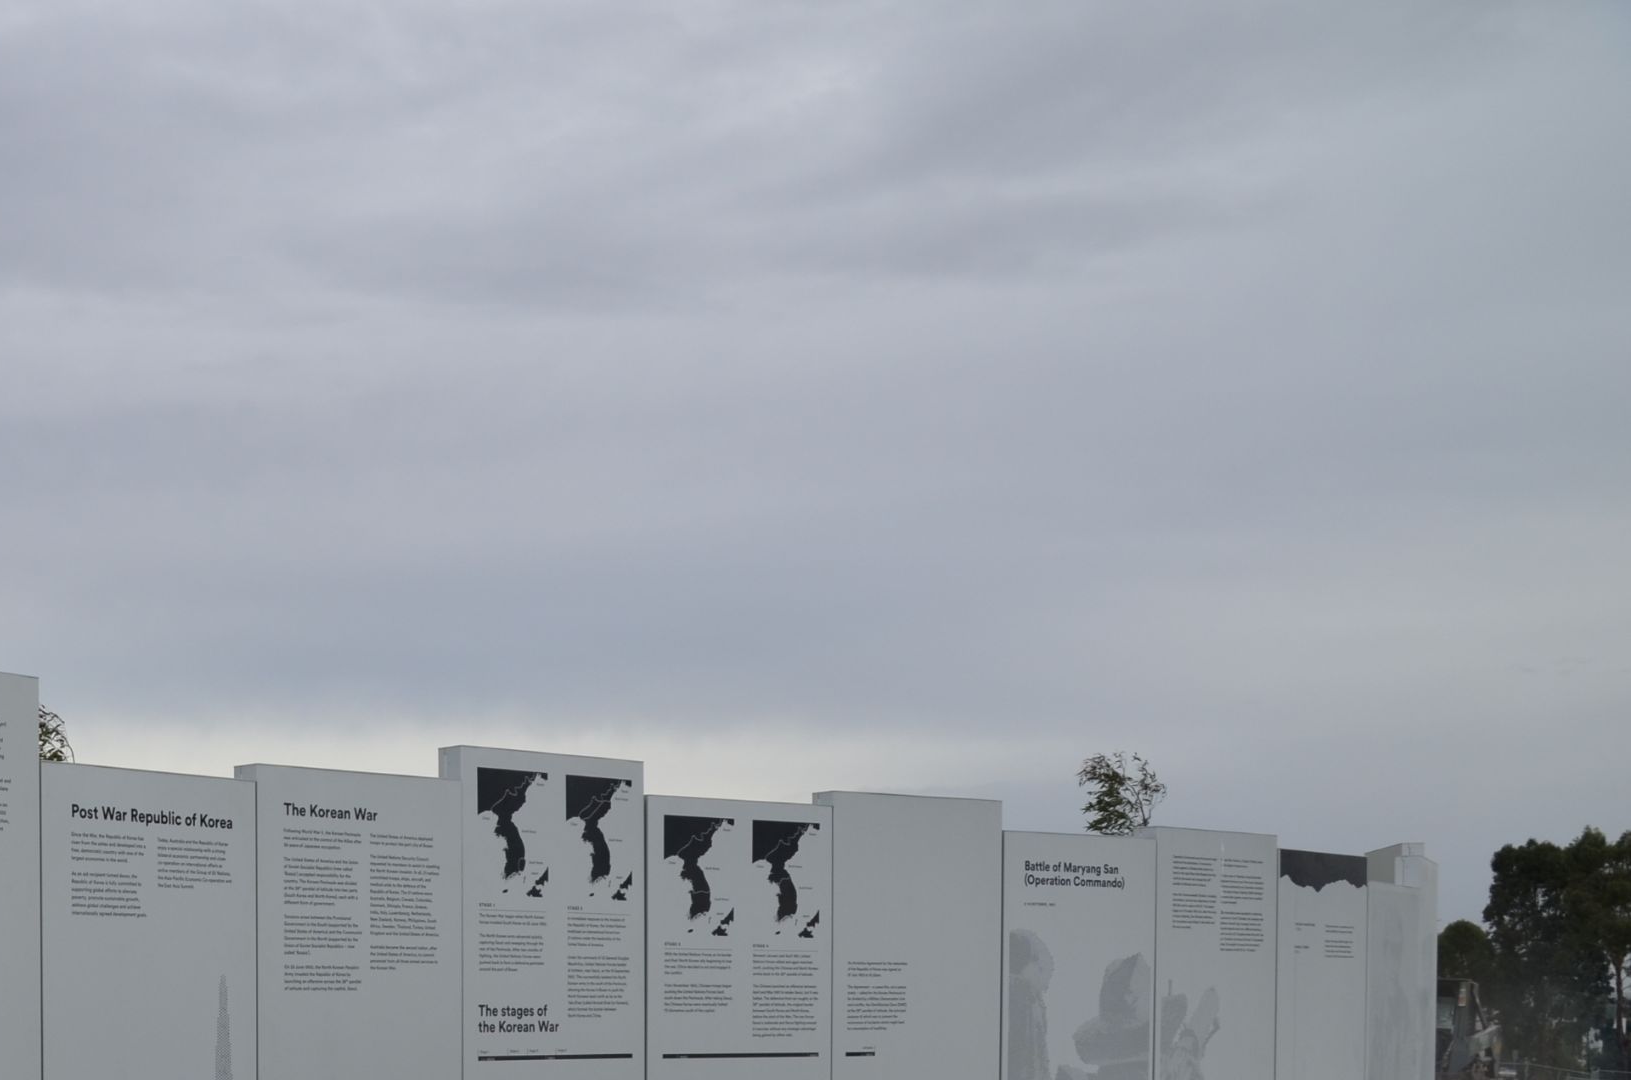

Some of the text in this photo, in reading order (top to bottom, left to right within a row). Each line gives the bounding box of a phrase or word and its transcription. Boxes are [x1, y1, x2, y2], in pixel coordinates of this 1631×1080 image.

[71, 803, 233, 829] Post War Republic of Korea
[283, 802, 378, 821] The Korean War
[1024, 860, 1119, 876] Battle of Maryang San
[1024, 873, 1125, 890] (Operation Commando)
[478, 1004, 548, 1019] The stages of
[478, 1020, 559, 1033] the Korean War
